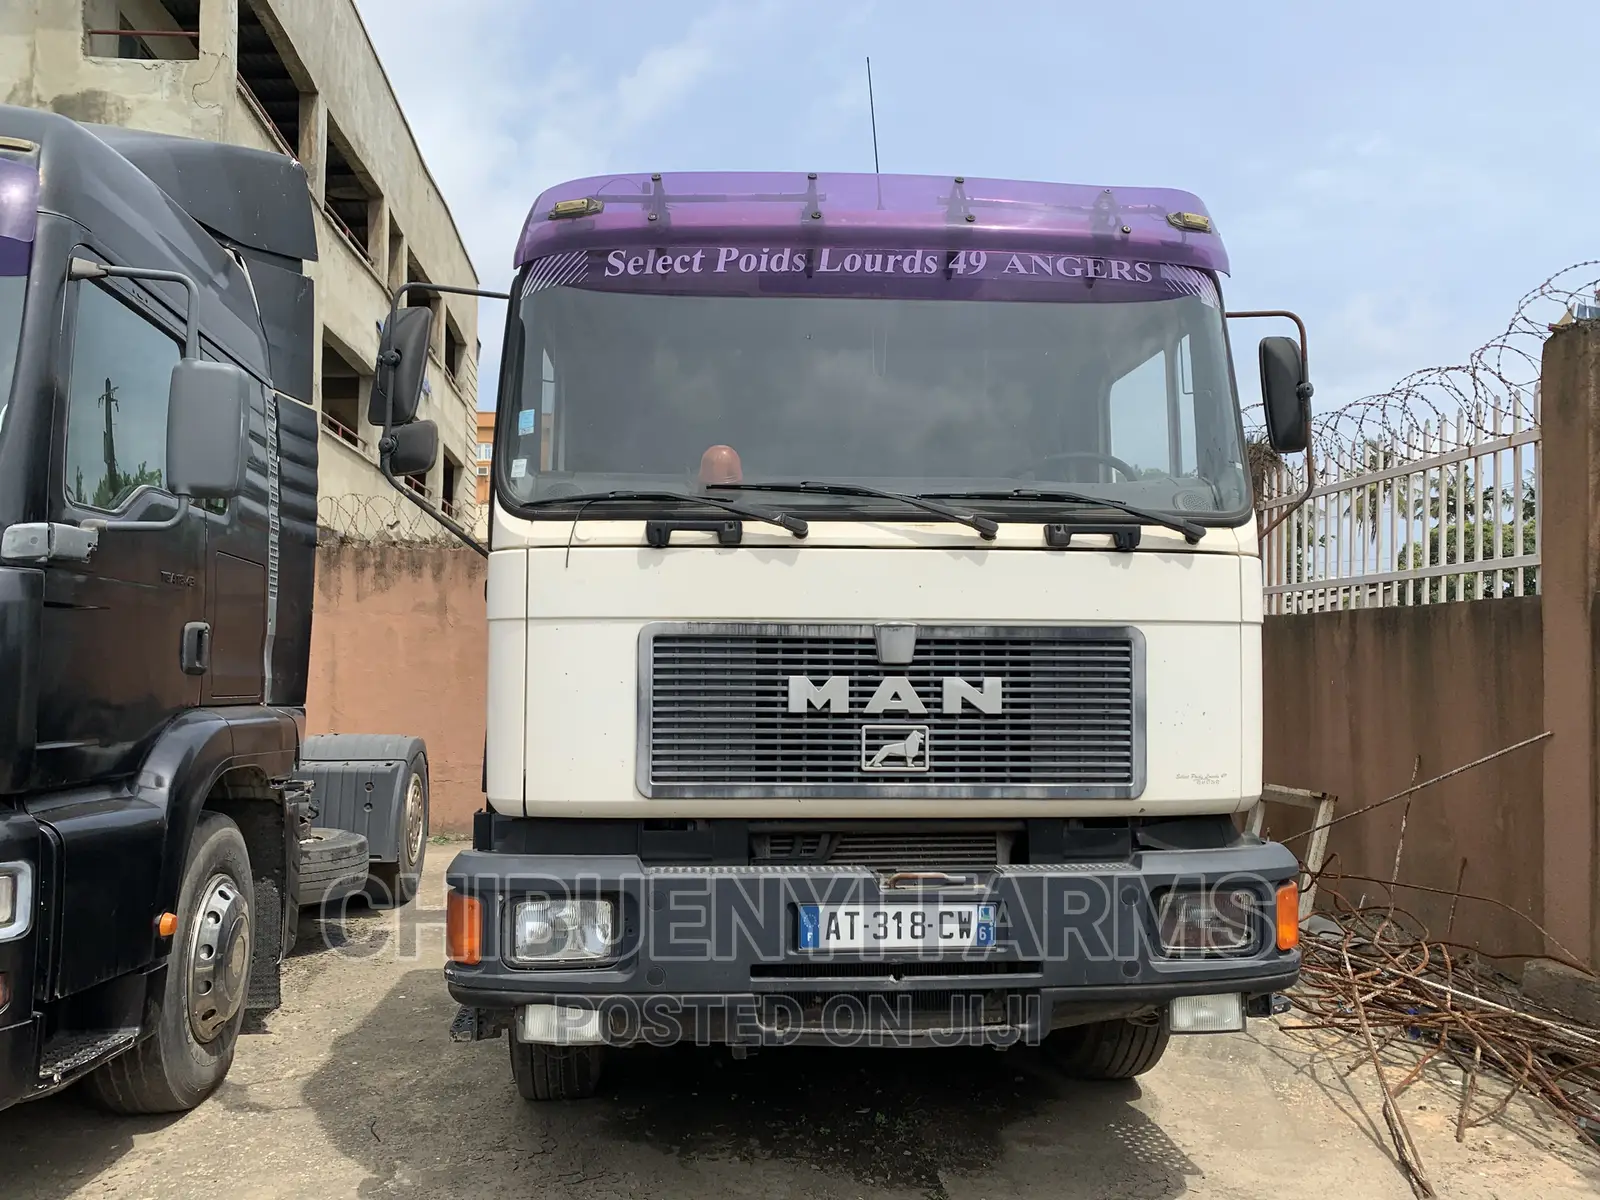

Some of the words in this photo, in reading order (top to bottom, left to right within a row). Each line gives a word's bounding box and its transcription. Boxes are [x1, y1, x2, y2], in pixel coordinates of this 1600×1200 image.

[604, 248, 705, 277] Select
[713, 247, 806, 274] Poids
[816, 247, 938, 275] Lourds
[948, 249, 988, 275] 49
[1002, 254, 1153, 283] ANGERS
[788, 675, 1002, 715] MAN
[825, 911, 973, 941] AT-318-CW
